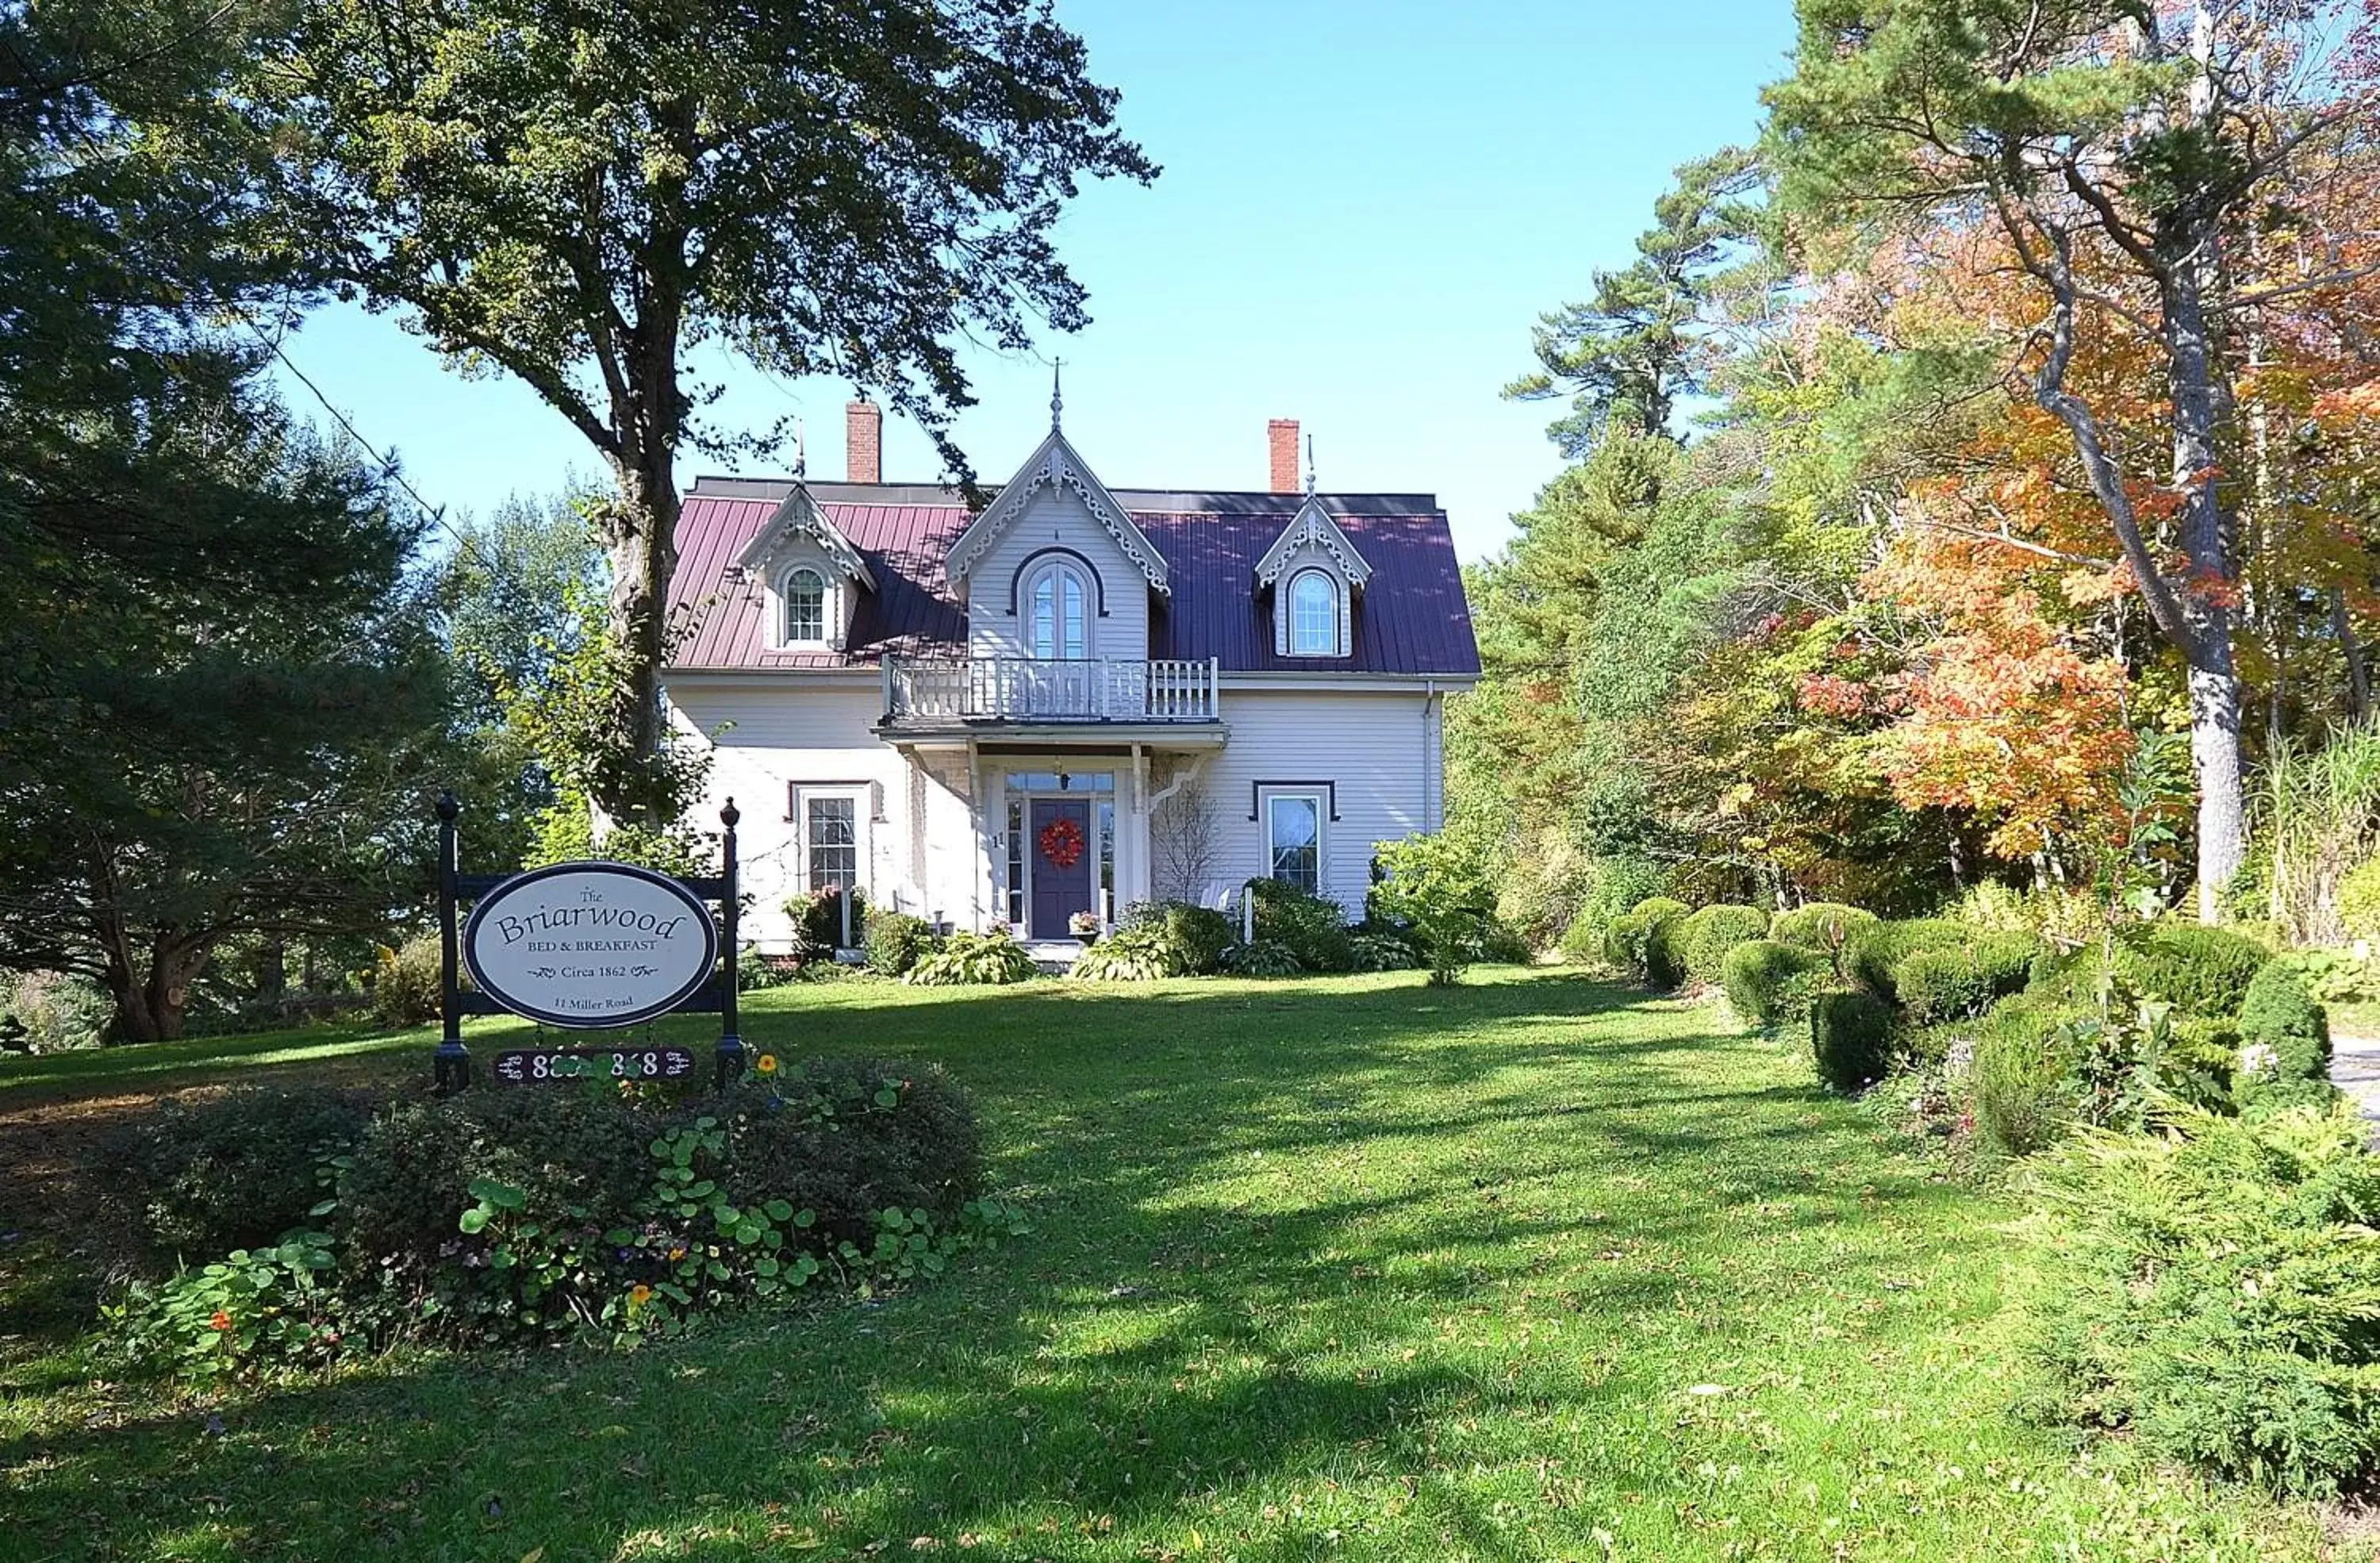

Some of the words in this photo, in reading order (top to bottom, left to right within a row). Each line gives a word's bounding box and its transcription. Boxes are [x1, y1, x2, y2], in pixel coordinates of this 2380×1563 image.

[581, 889, 603, 902] The
[495, 905, 687, 945] Briarwood
[528, 941, 556, 952] BED
[560, 941, 571, 951] &
[576, 939, 658, 952] BREAKFAST
[561, 966, 594, 977] Circa
[600, 966, 627, 977] 1862
[568, 999, 602, 1010] Miller
[605, 996, 634, 1008] Road
